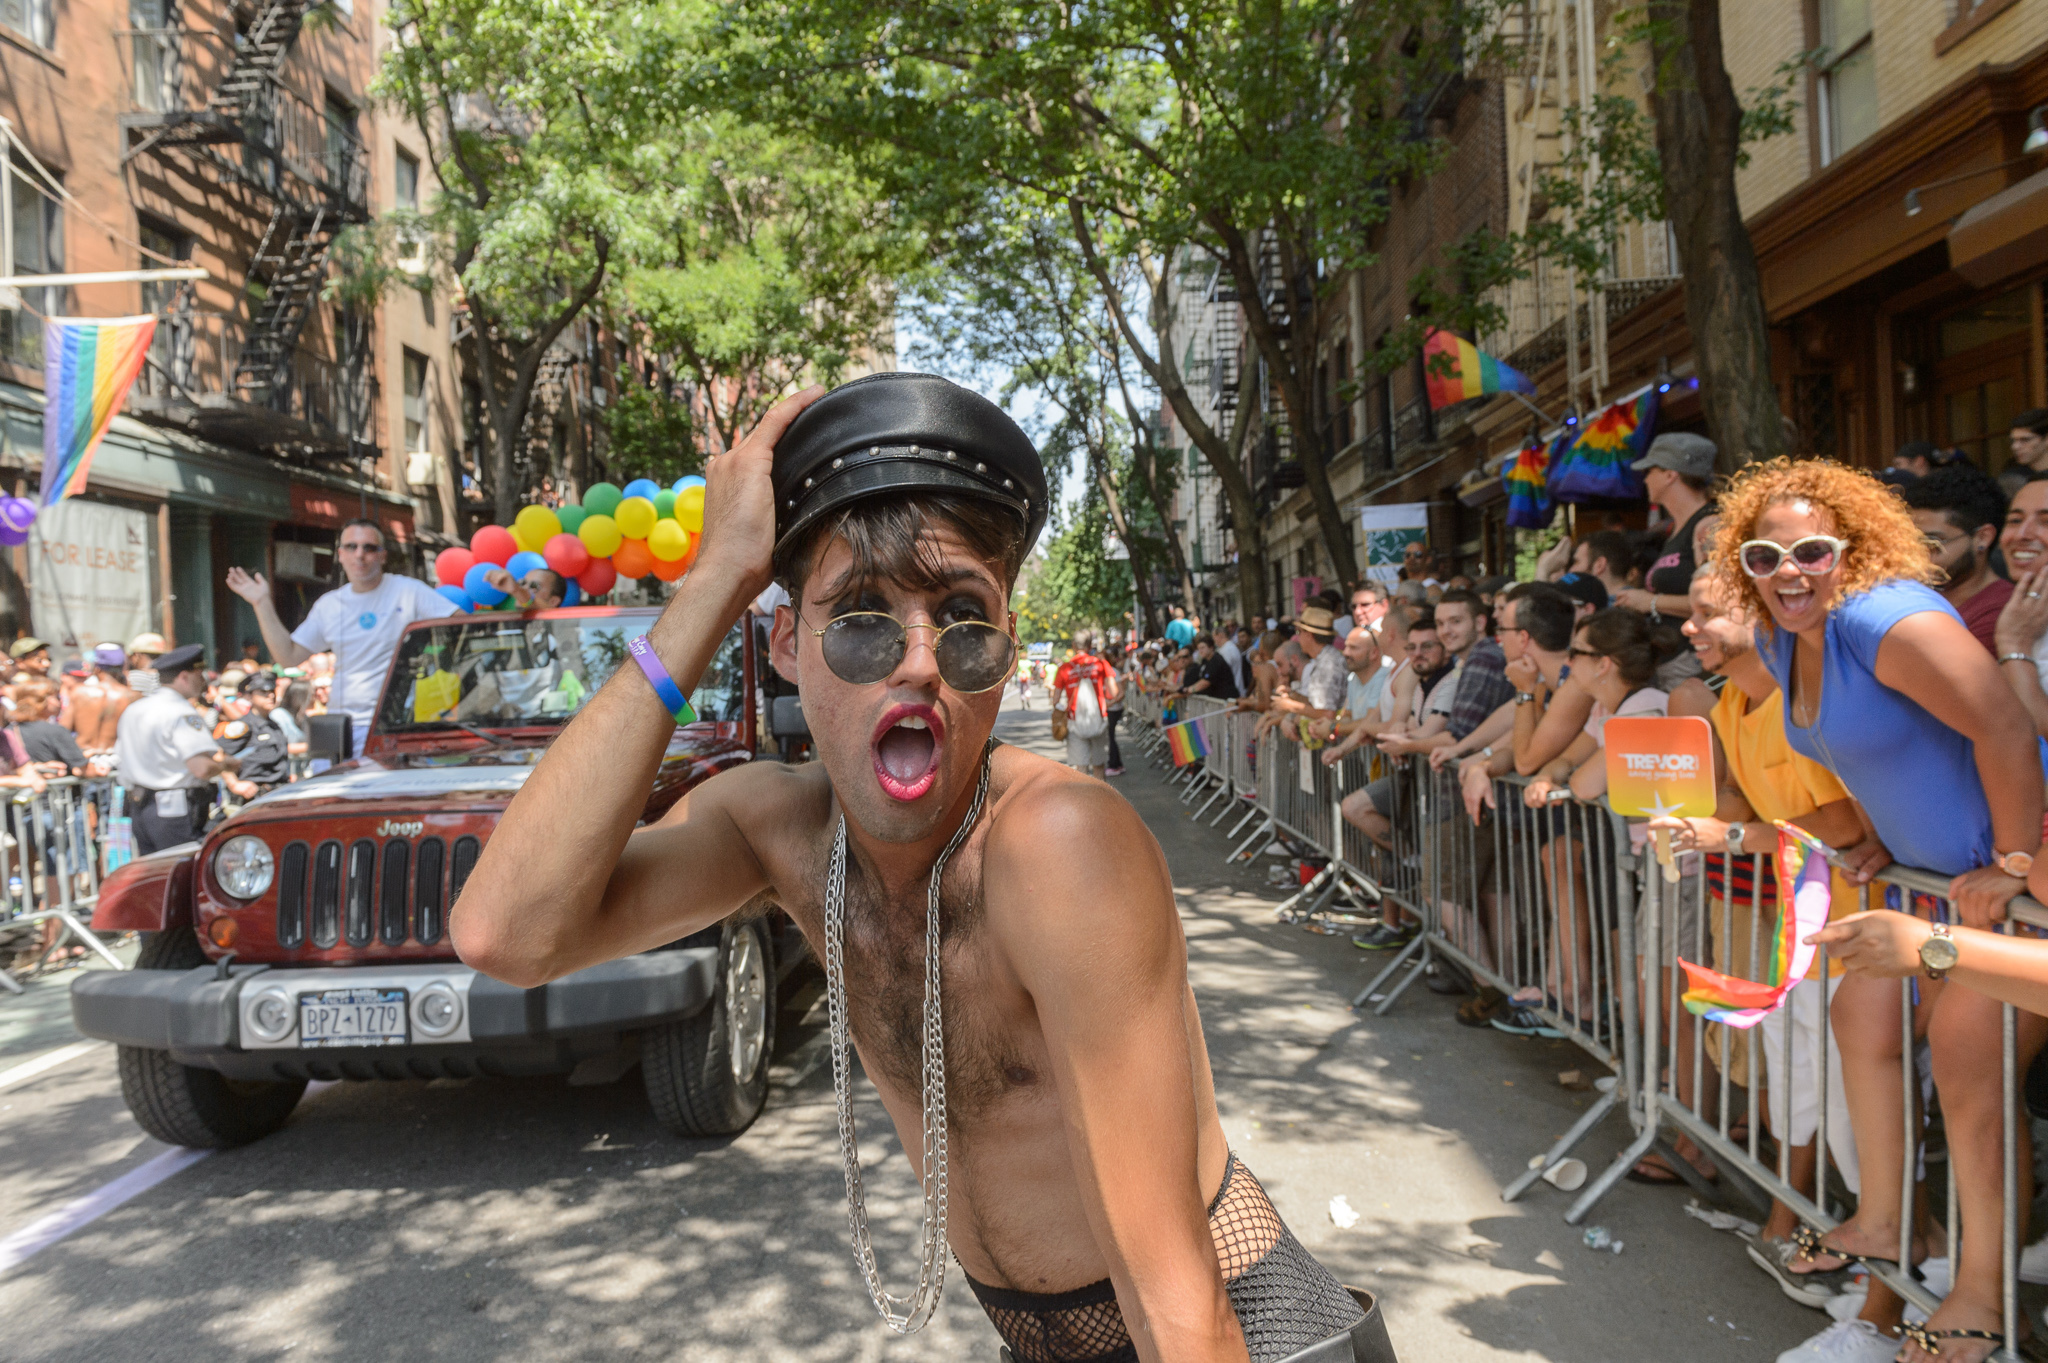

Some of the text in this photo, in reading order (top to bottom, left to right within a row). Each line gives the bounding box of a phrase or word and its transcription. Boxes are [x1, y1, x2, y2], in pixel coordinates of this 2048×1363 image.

[41, 540, 137, 573] FOR LEASE
[1618, 753, 1695, 771] TREVOR
[376, 819, 424, 839] Jeep
[307, 1005, 398, 1035] BPZ 1279
